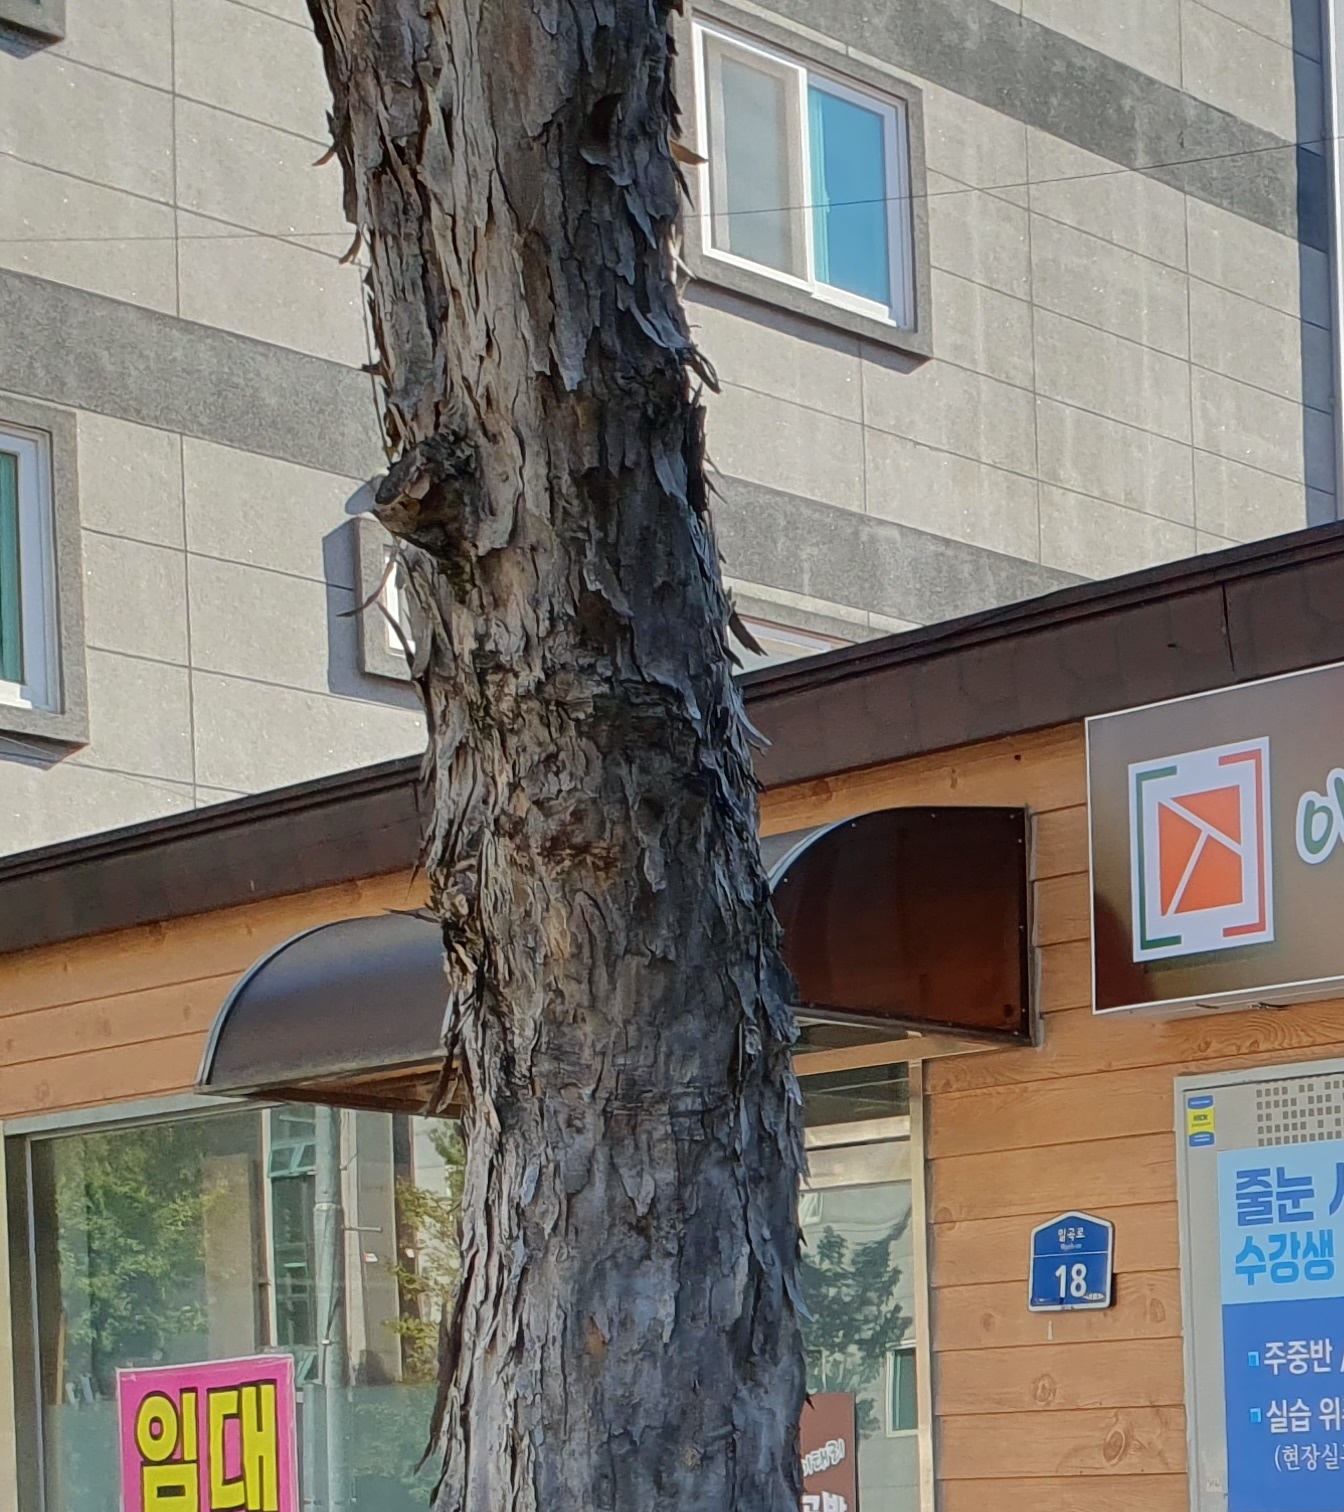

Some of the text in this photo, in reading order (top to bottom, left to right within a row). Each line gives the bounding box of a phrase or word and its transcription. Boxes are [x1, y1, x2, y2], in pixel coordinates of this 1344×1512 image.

[1235, 1165, 1315, 1226] 줄눈
[1234, 1229, 1334, 1286] 수강생
[1055, 1264, 1087, 1297] 18
[1263, 1338, 1332, 1376] 주중반
[1266, 1399, 1312, 1433] 실습
